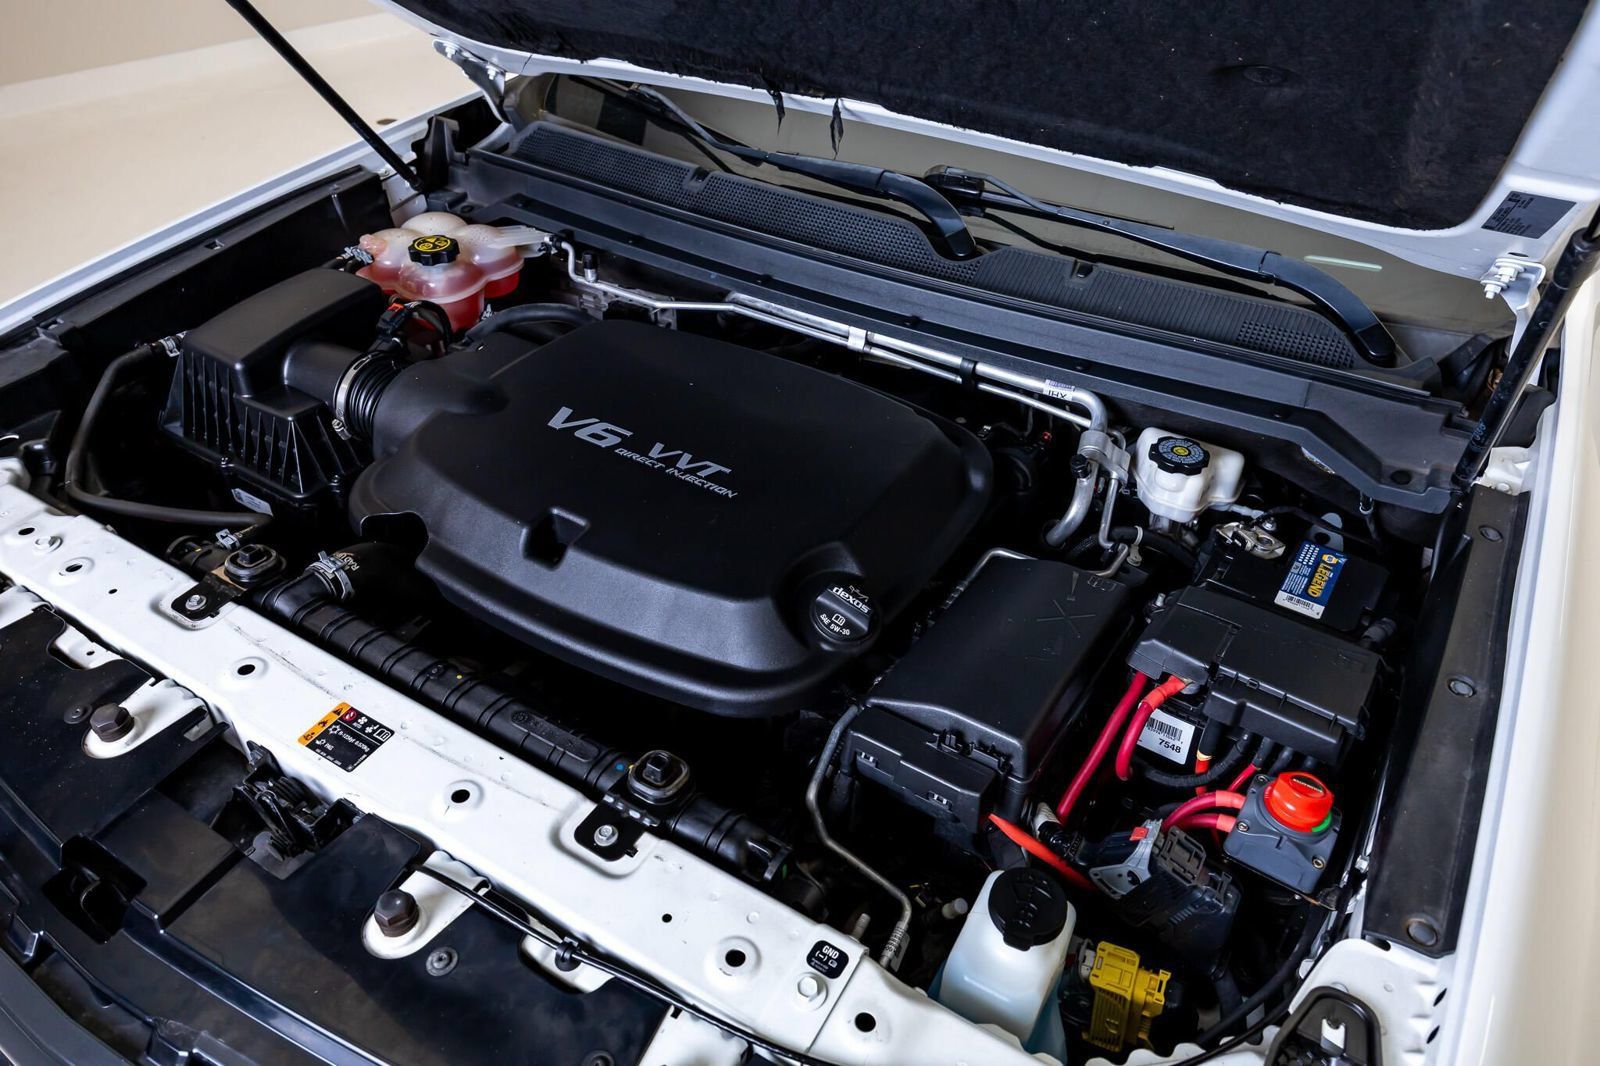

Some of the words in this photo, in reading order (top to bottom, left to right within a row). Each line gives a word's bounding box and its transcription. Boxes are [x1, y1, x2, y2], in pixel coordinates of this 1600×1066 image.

[547, 406, 634, 448] V6
[614, 447, 666, 469] DIRECT
[665, 467, 738, 498] INJECTION
[648, 441, 732, 477] VVT
[1307, 562, 1333, 598] LEGEND
[832, 586, 872, 614] dexos
[819, 613, 831, 626] SAE
[1158, 737, 1182, 754] 7548
[821, 944, 840, 960] GND
